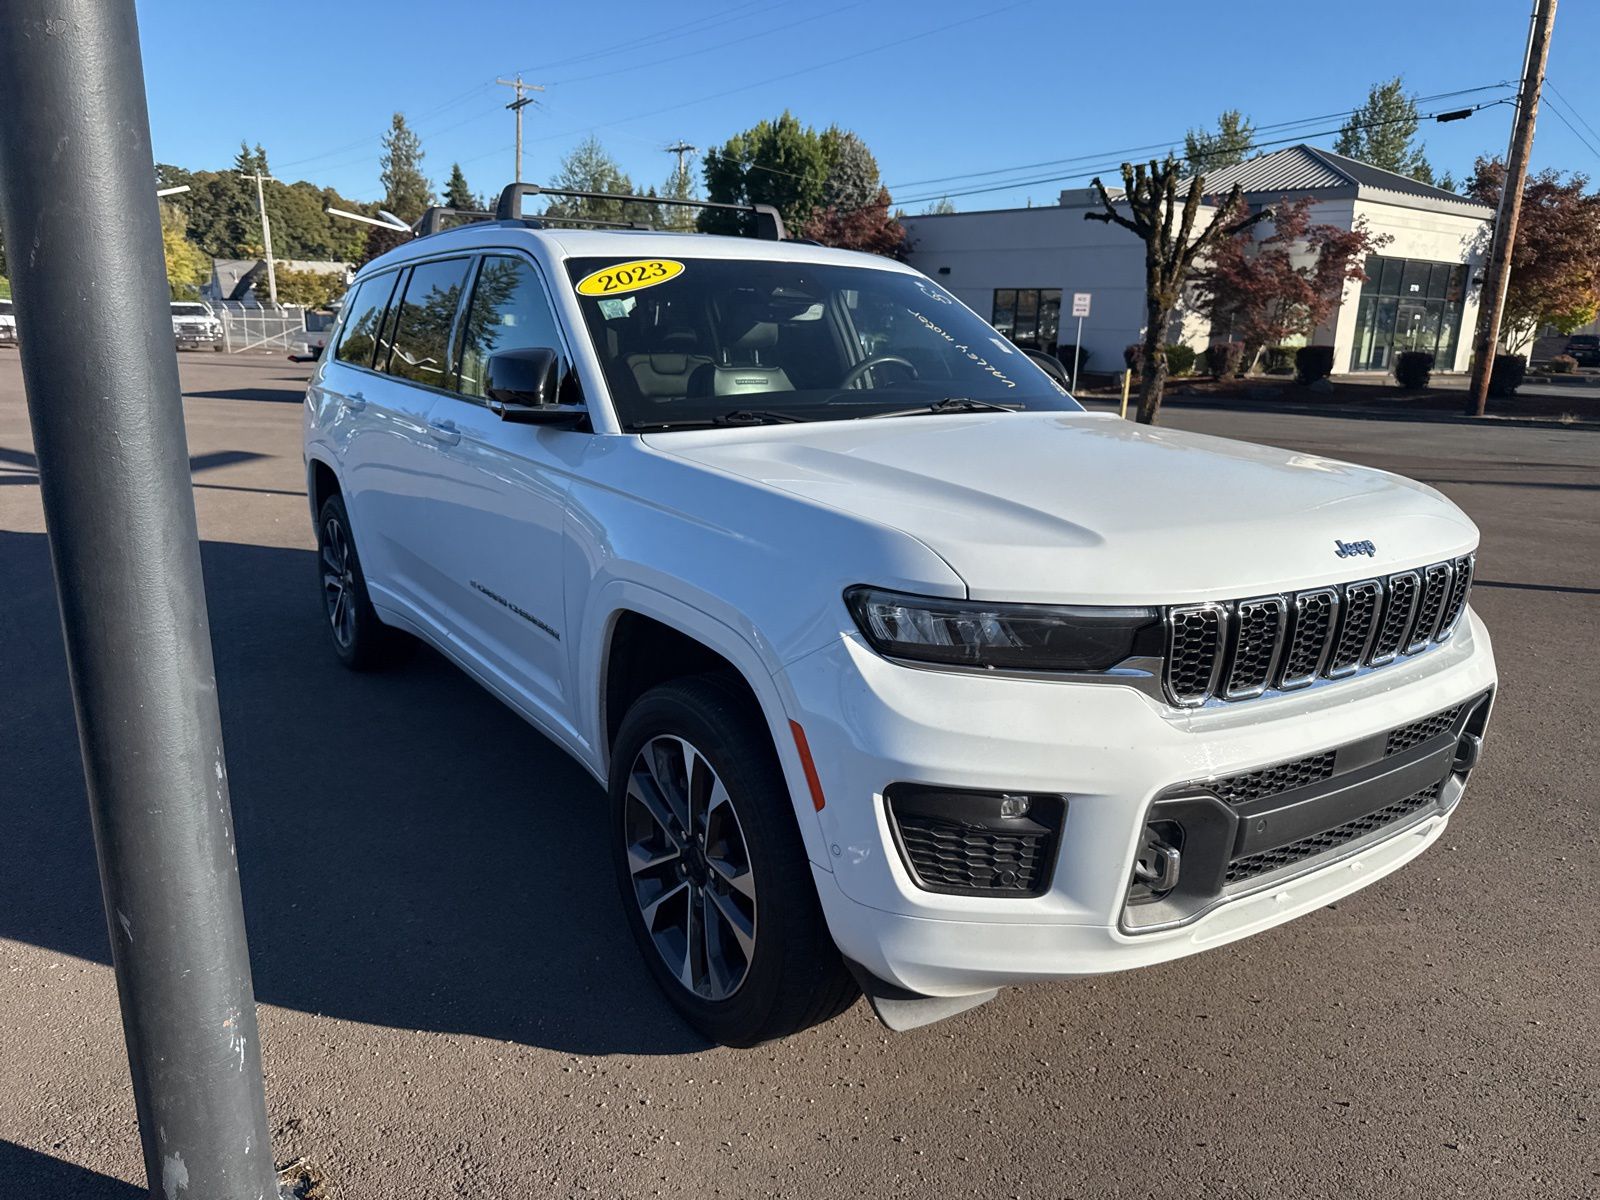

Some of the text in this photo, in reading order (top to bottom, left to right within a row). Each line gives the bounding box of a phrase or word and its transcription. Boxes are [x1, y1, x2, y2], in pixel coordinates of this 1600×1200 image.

[597, 262, 668, 292] 2023
[955, 344, 1016, 388] VALLEY
[1334, 539, 1377, 559] Jeep
